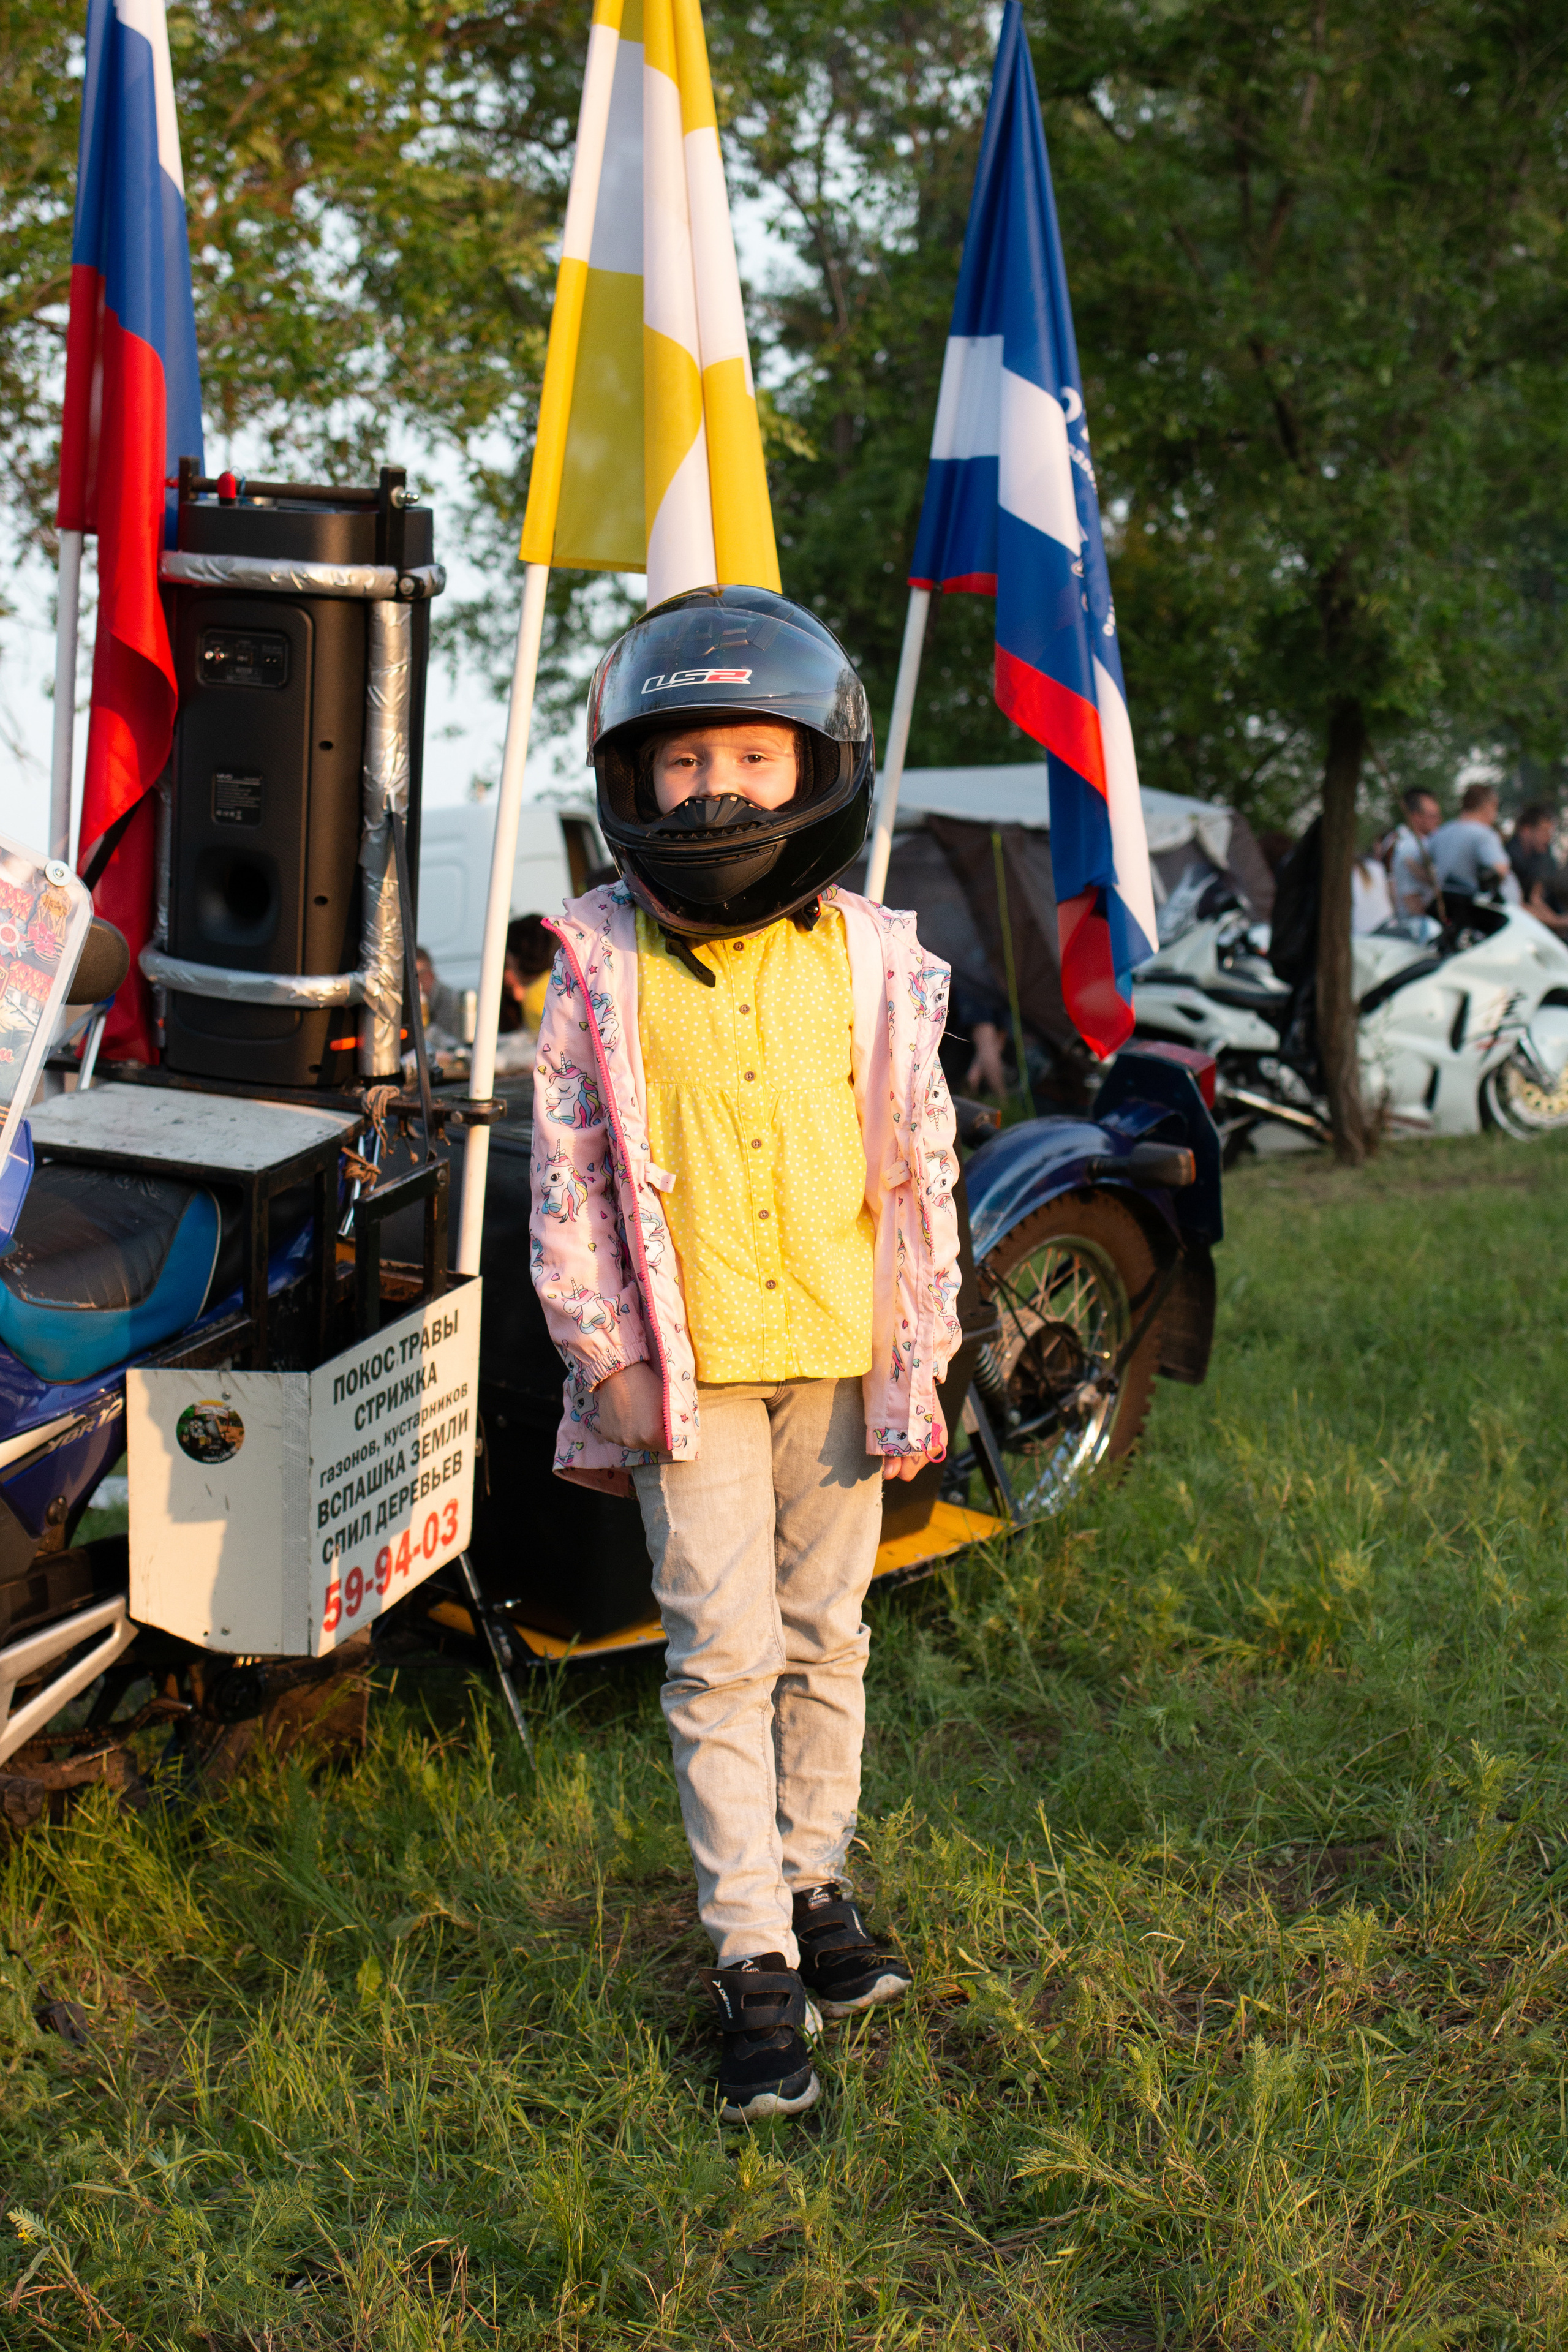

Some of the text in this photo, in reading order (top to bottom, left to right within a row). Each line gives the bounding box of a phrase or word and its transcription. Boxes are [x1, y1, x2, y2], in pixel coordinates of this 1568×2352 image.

[641, 668, 753, 695] LS2
[334, 1308, 459, 1406] ПОКОС ТРАВЫ
[354, 1361, 438, 1432] СТРИЖКА
[48, 1419, 96, 1453] YBR
[318, 1408, 469, 1529] ВСПАШКА ЗЕМЛИ
[320, 1382, 468, 1489] газонов, кустарников
[322, 1450, 462, 1565] СПИЛ ДЕРЕВЬЕВ
[323, 1498, 459, 1633] 59-94-03
[718, 1988, 733, 2019] DEMIX
